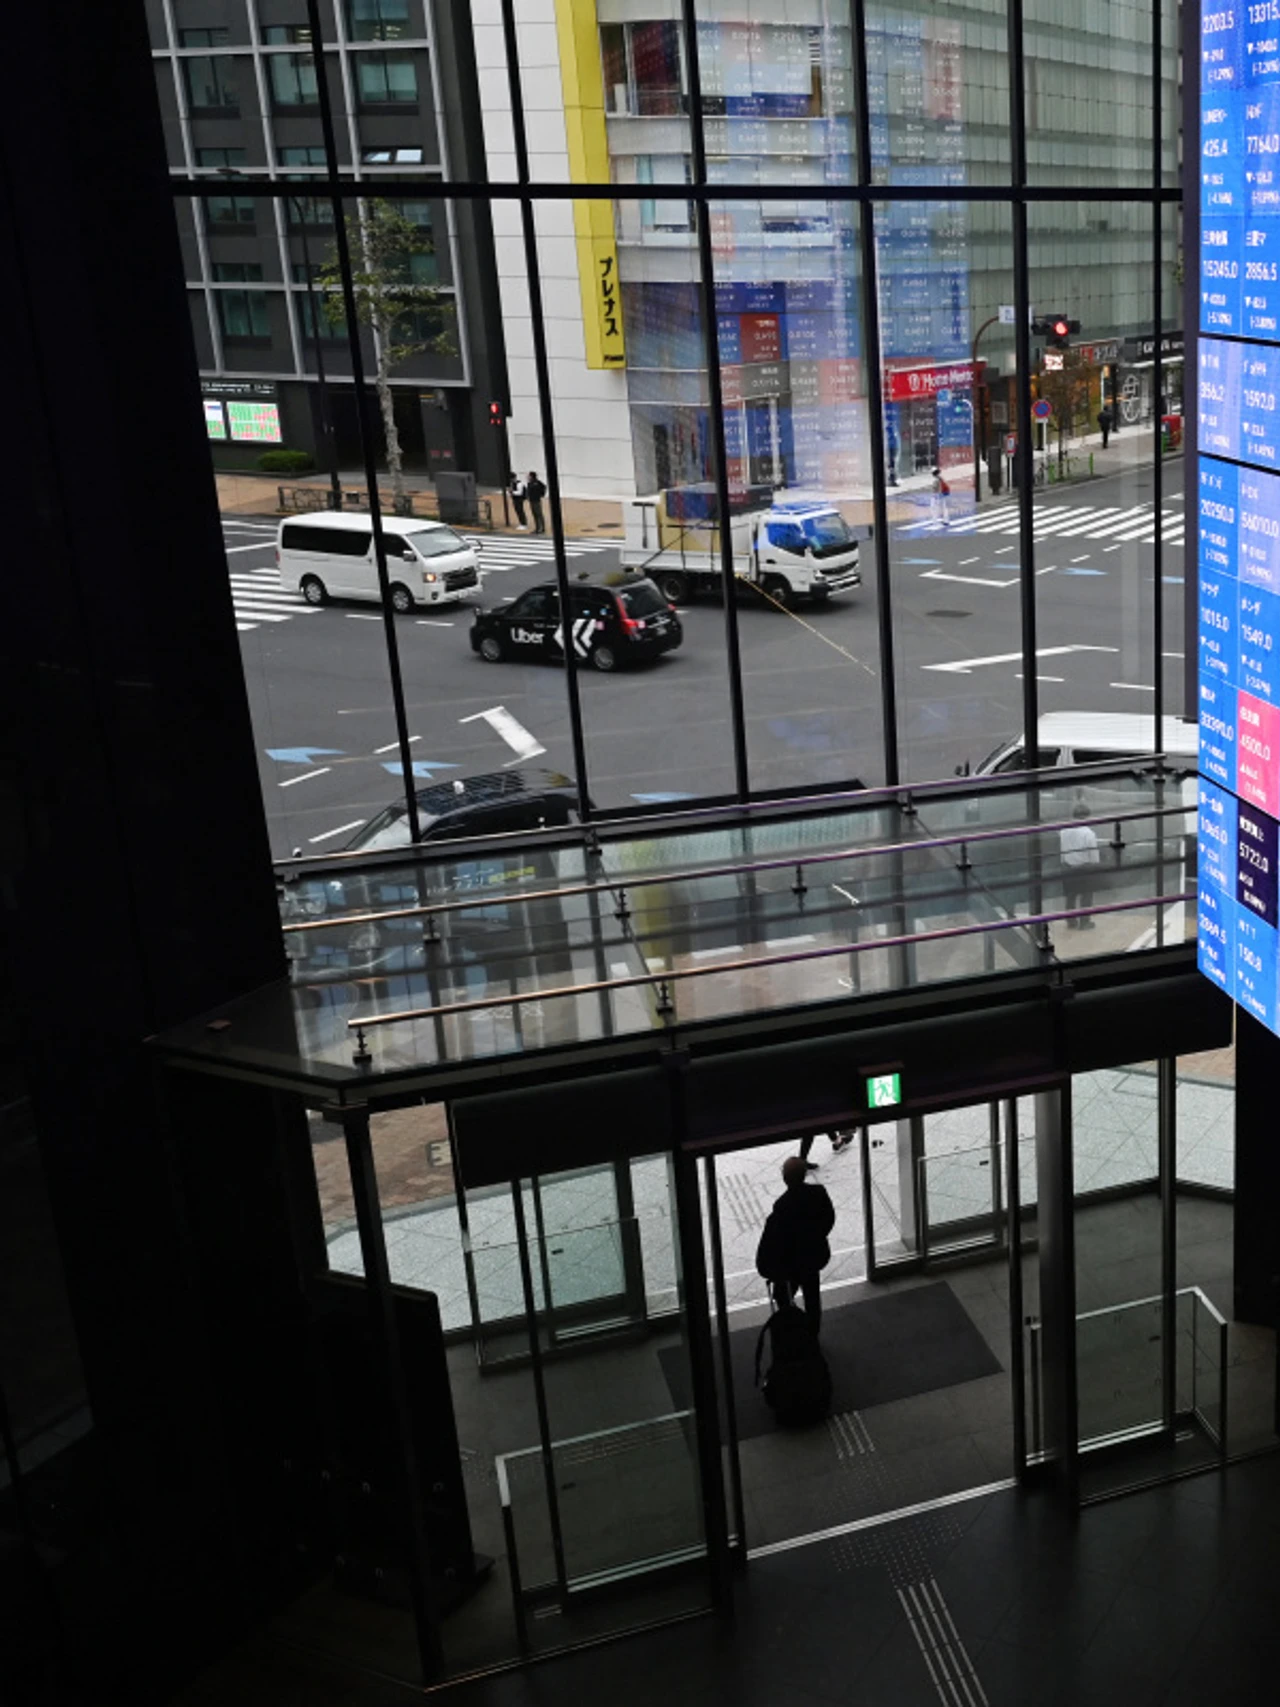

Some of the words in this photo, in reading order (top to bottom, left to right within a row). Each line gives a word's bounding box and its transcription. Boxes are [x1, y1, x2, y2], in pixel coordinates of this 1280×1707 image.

[599, 256, 619, 337] プレナス
[511, 627, 544, 644] Uber
